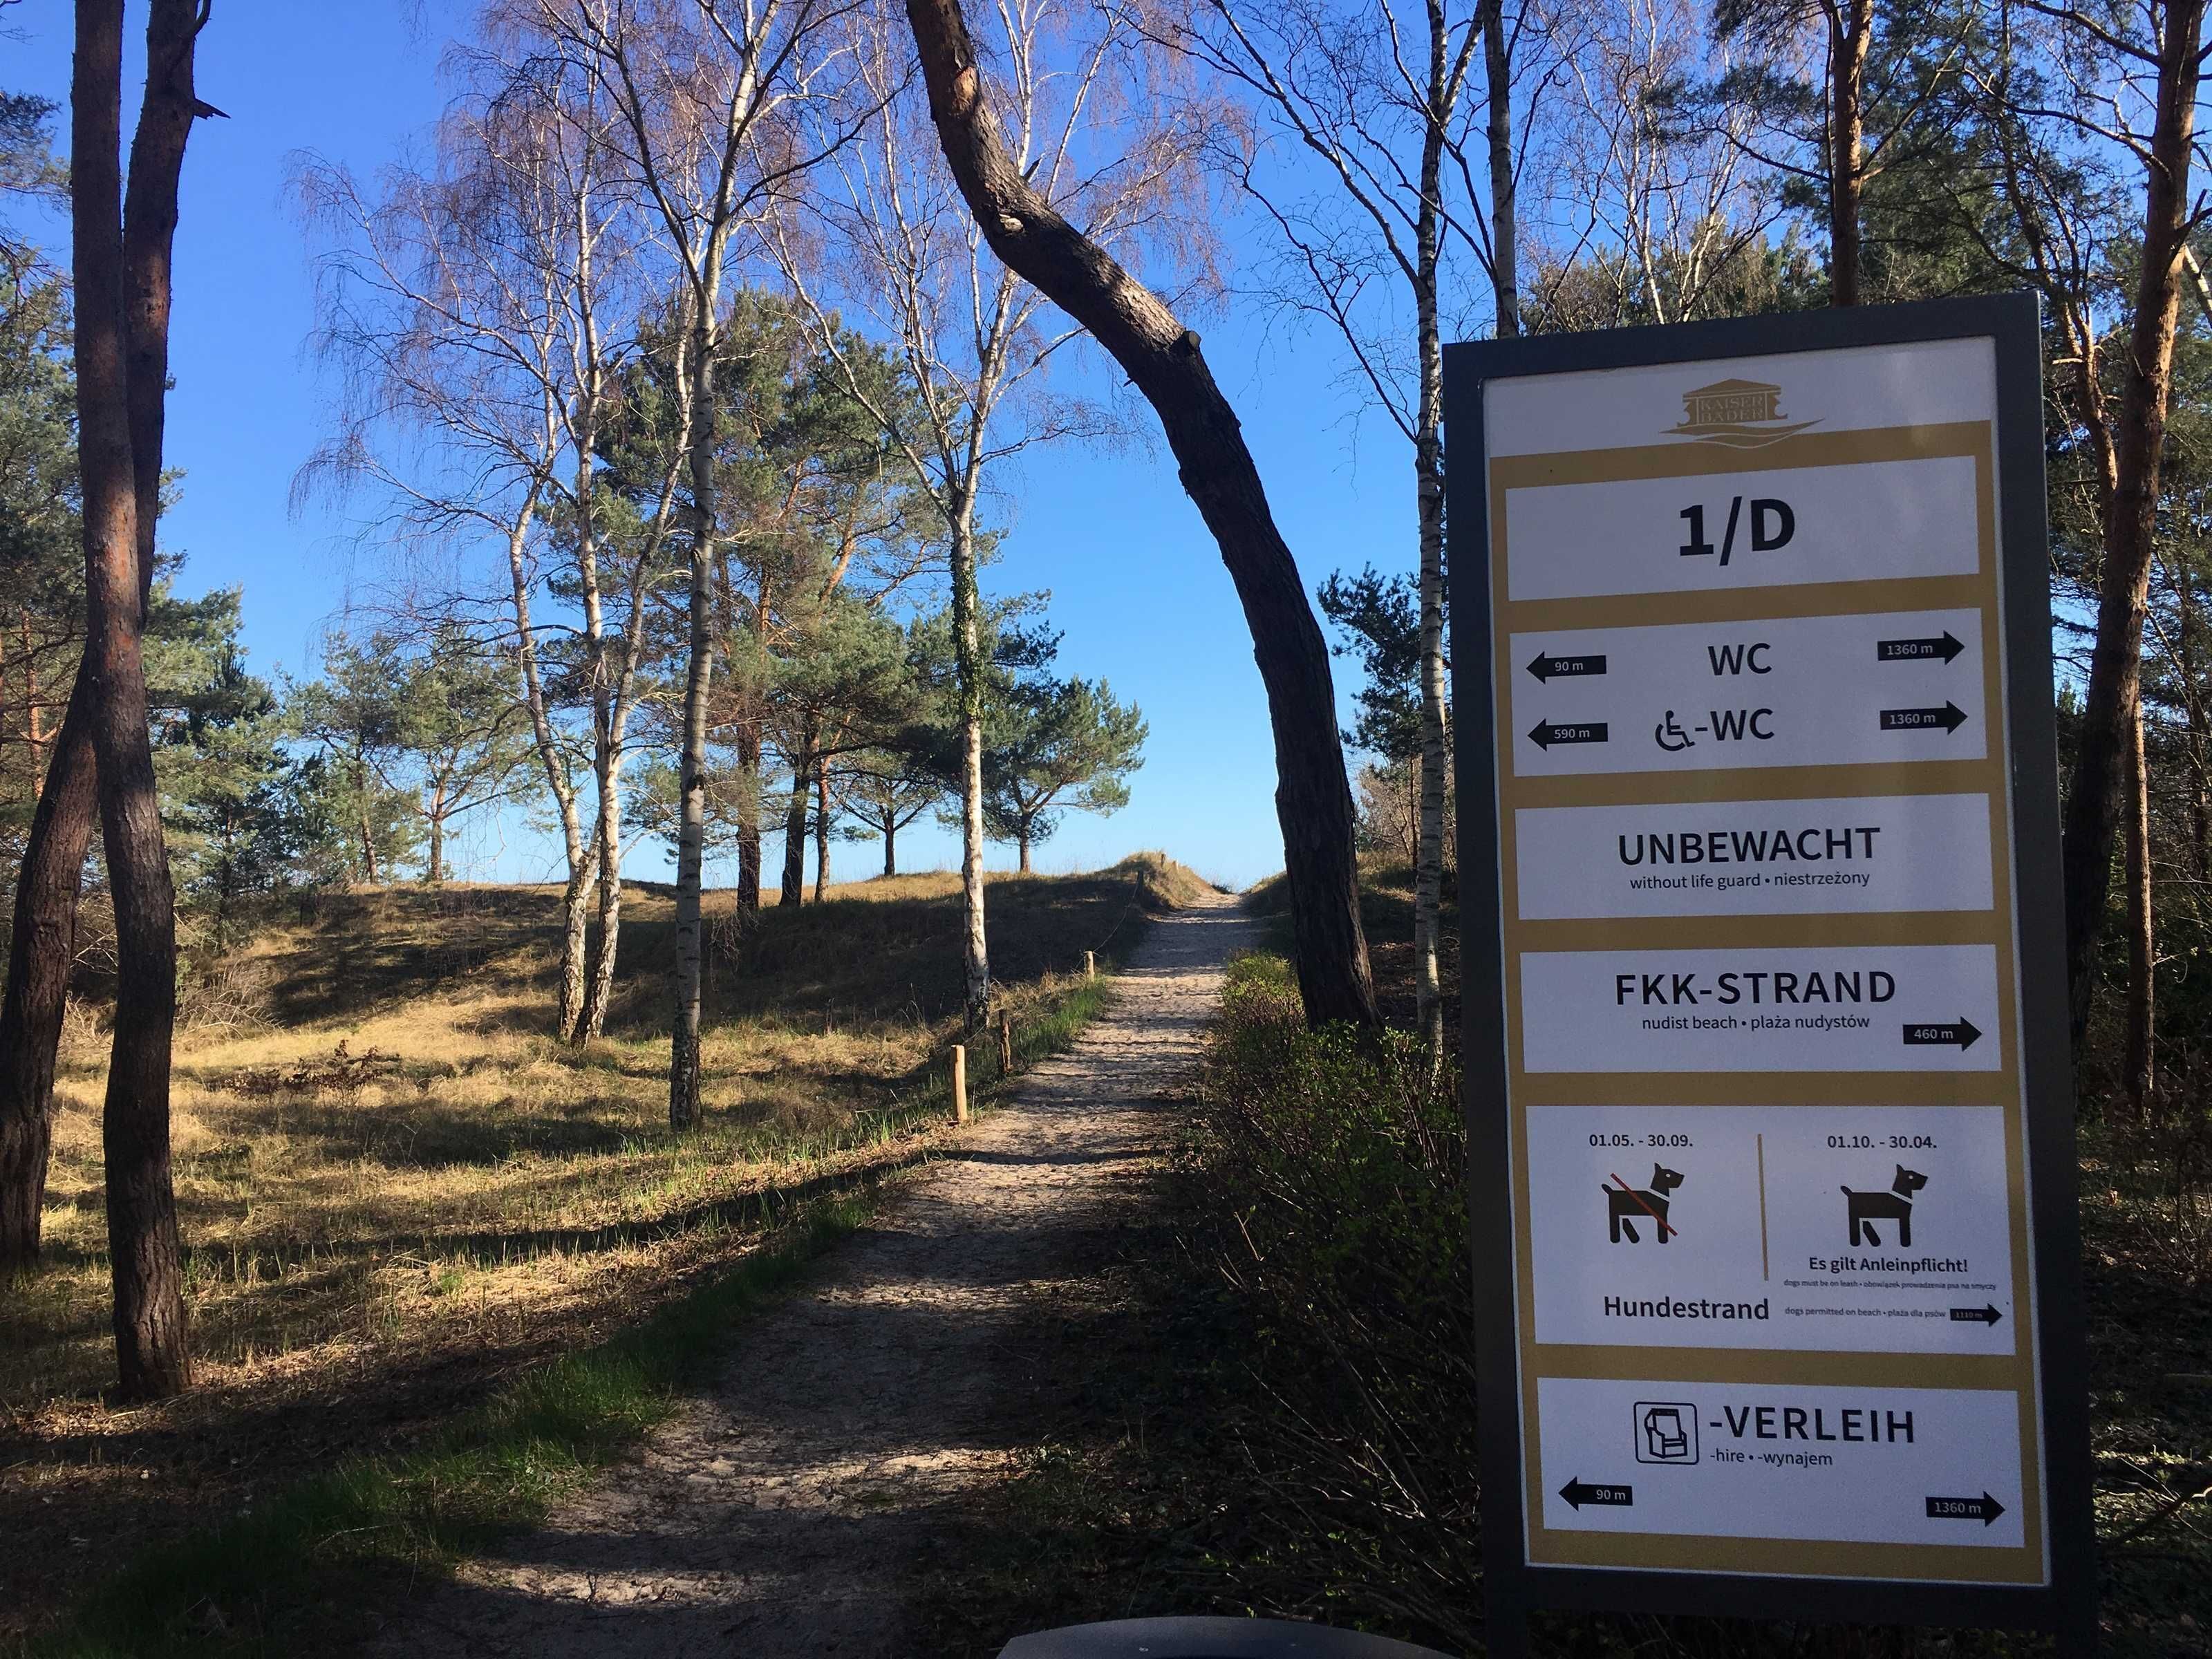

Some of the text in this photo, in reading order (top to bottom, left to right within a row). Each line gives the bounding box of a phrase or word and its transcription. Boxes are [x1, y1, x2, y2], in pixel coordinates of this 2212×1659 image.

[1700, 396, 1764, 410] KAISER
[1680, 496, 1795, 566] 1/D
[1887, 644, 1933, 655] 1360 m
[1555, 662, 1584, 671] 90 m
[1707, 643, 1772, 676] WC
[1890, 713, 1936, 724] 1360 m
[1554, 729, 1590, 739] 590 m
[1619, 827, 1881, 865] UNBEWACHT
[1630, 872, 1871, 890] without life guard niestrzeżony
[1616, 971, 1895, 1005] FKK-STRAND
[1642, 1014, 1870, 1031] nudist beach plaża nudystów
[1913, 1029, 1953, 1040] 460 m
[1589, 1134, 1634, 1147] 01.05.
[1647, 1134, 1694, 1147] 30.09.
[1828, 1135, 1875, 1148] 01.10.
[1889, 1136, 1938, 1149] 30.04.
[1809, 1257, 1969, 1275] Es gilt Anleinpflicht!
[1784, 1279, 1801, 1288] dogs
[1604, 1296, 1770, 1320] Hundestrand
[1785, 1306, 1804, 1316] dogs
[1710, 1405, 1914, 1443] -VERLEIH
[1710, 1448, 1833, 1469] -hire -wynajem
[1596, 1490, 1626, 1500] 90 m
[1935, 1502, 1982, 1514] 1360 m
